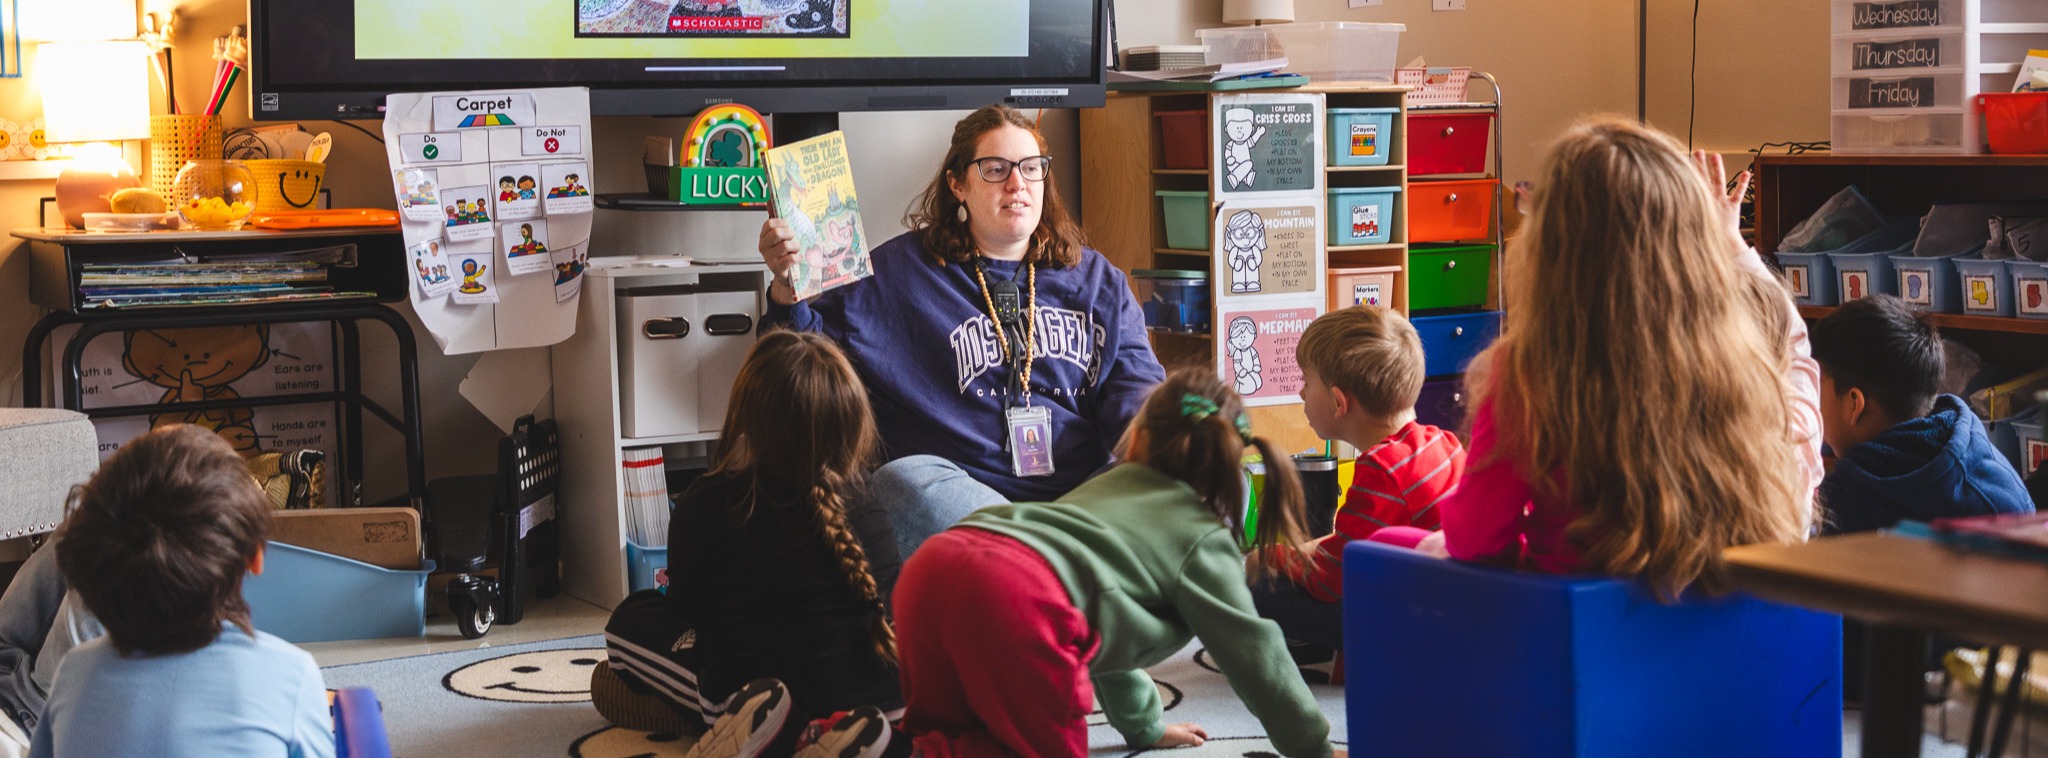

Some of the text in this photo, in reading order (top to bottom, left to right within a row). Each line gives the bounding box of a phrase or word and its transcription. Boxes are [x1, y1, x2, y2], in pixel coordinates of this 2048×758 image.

[683, 19, 760, 27] SCHOLASTIC
[1853, 2, 1938, 26] Wednesday
[1856, 42, 1936, 67] Thursday
[1868, 81, 1919, 107] Friday
[456, 96, 512, 113] Carpet
[1255, 113, 1312, 124] CRISS CROSS
[424, 135, 436, 143] Do
[536, 129, 566, 137] Do Not
[800, 136, 841, 155] THERE WAS AN
[803, 145, 840, 166] OLD LADY
[814, 156, 845, 172] SWALLOWED
[811, 165, 846, 184] DRAGON!
[692, 174, 768, 198] LUCKY
[1353, 206, 1368, 214] Glue
[1264, 217, 1314, 228] MOUNTAIN
[2018, 234, 2030, 252] 5
[1792, 270, 1801, 292] 1
[1849, 274, 1861, 298] 2
[1908, 274, 1922, 298] 3
[1972, 280, 1988, 304] 4
[2026, 284, 2042, 308] 5
[950, 313, 1004, 394] LOS
[104, 367, 112, 376] is
[274, 364, 323, 374] Ears are
[272, 420, 326, 431] Hands are
[272, 439, 283, 447] to
